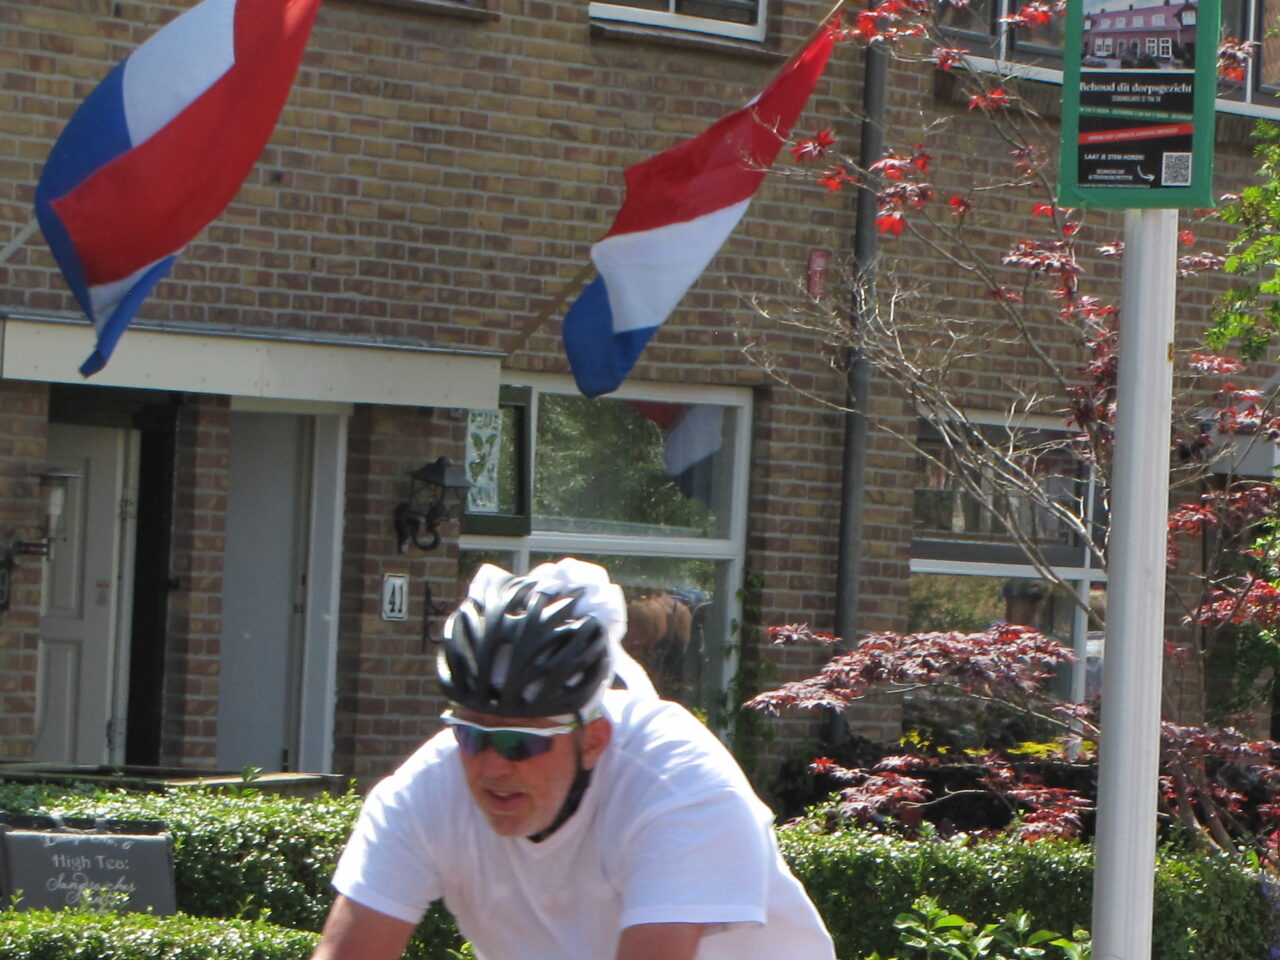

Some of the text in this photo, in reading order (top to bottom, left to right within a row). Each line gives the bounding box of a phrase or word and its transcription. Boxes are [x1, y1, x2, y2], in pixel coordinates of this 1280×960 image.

[1080, 82, 1115, 92] Behoud
[1117, 82, 1130, 92] dit
[389, 583, 404, 613] 41
[52, 854, 91, 871] High
